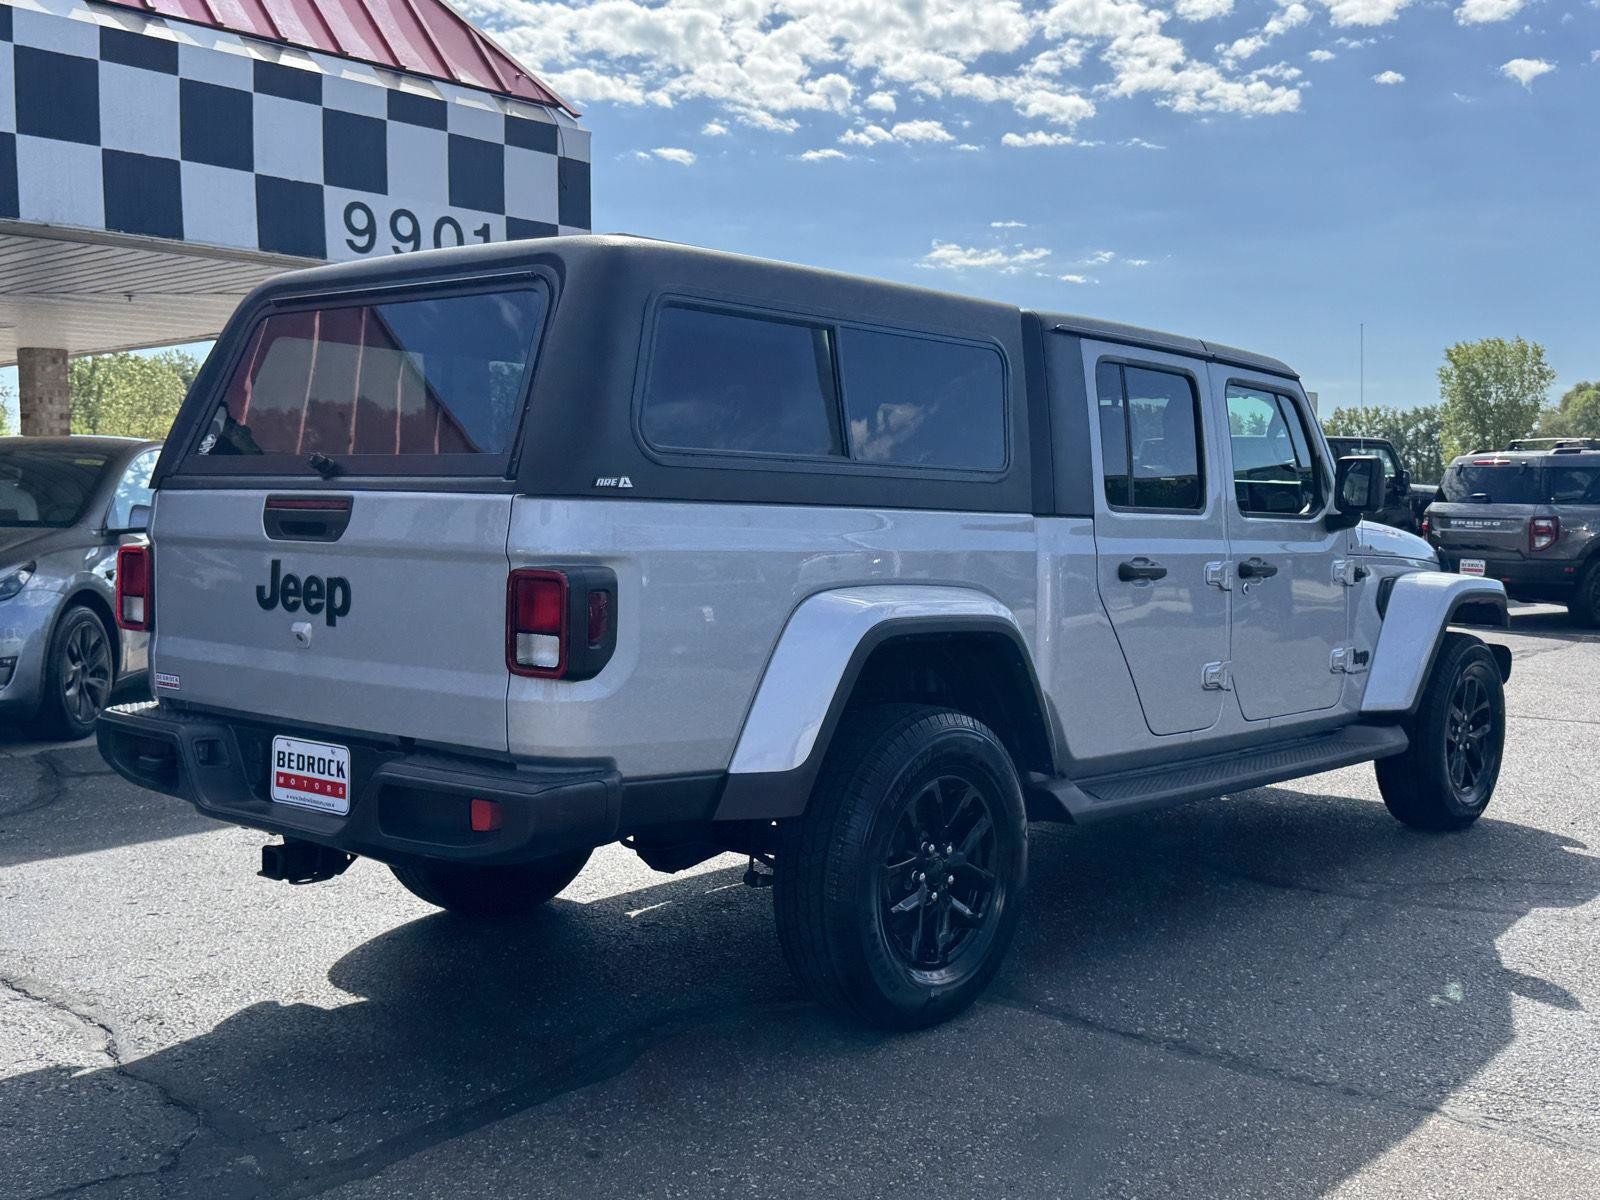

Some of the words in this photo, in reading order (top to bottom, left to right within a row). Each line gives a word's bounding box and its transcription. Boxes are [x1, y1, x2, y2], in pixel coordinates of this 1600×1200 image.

[255, 559, 352, 627] Jeep
[276, 750, 346, 779] BEDROCK
[278, 776, 344, 795] MOTORS
